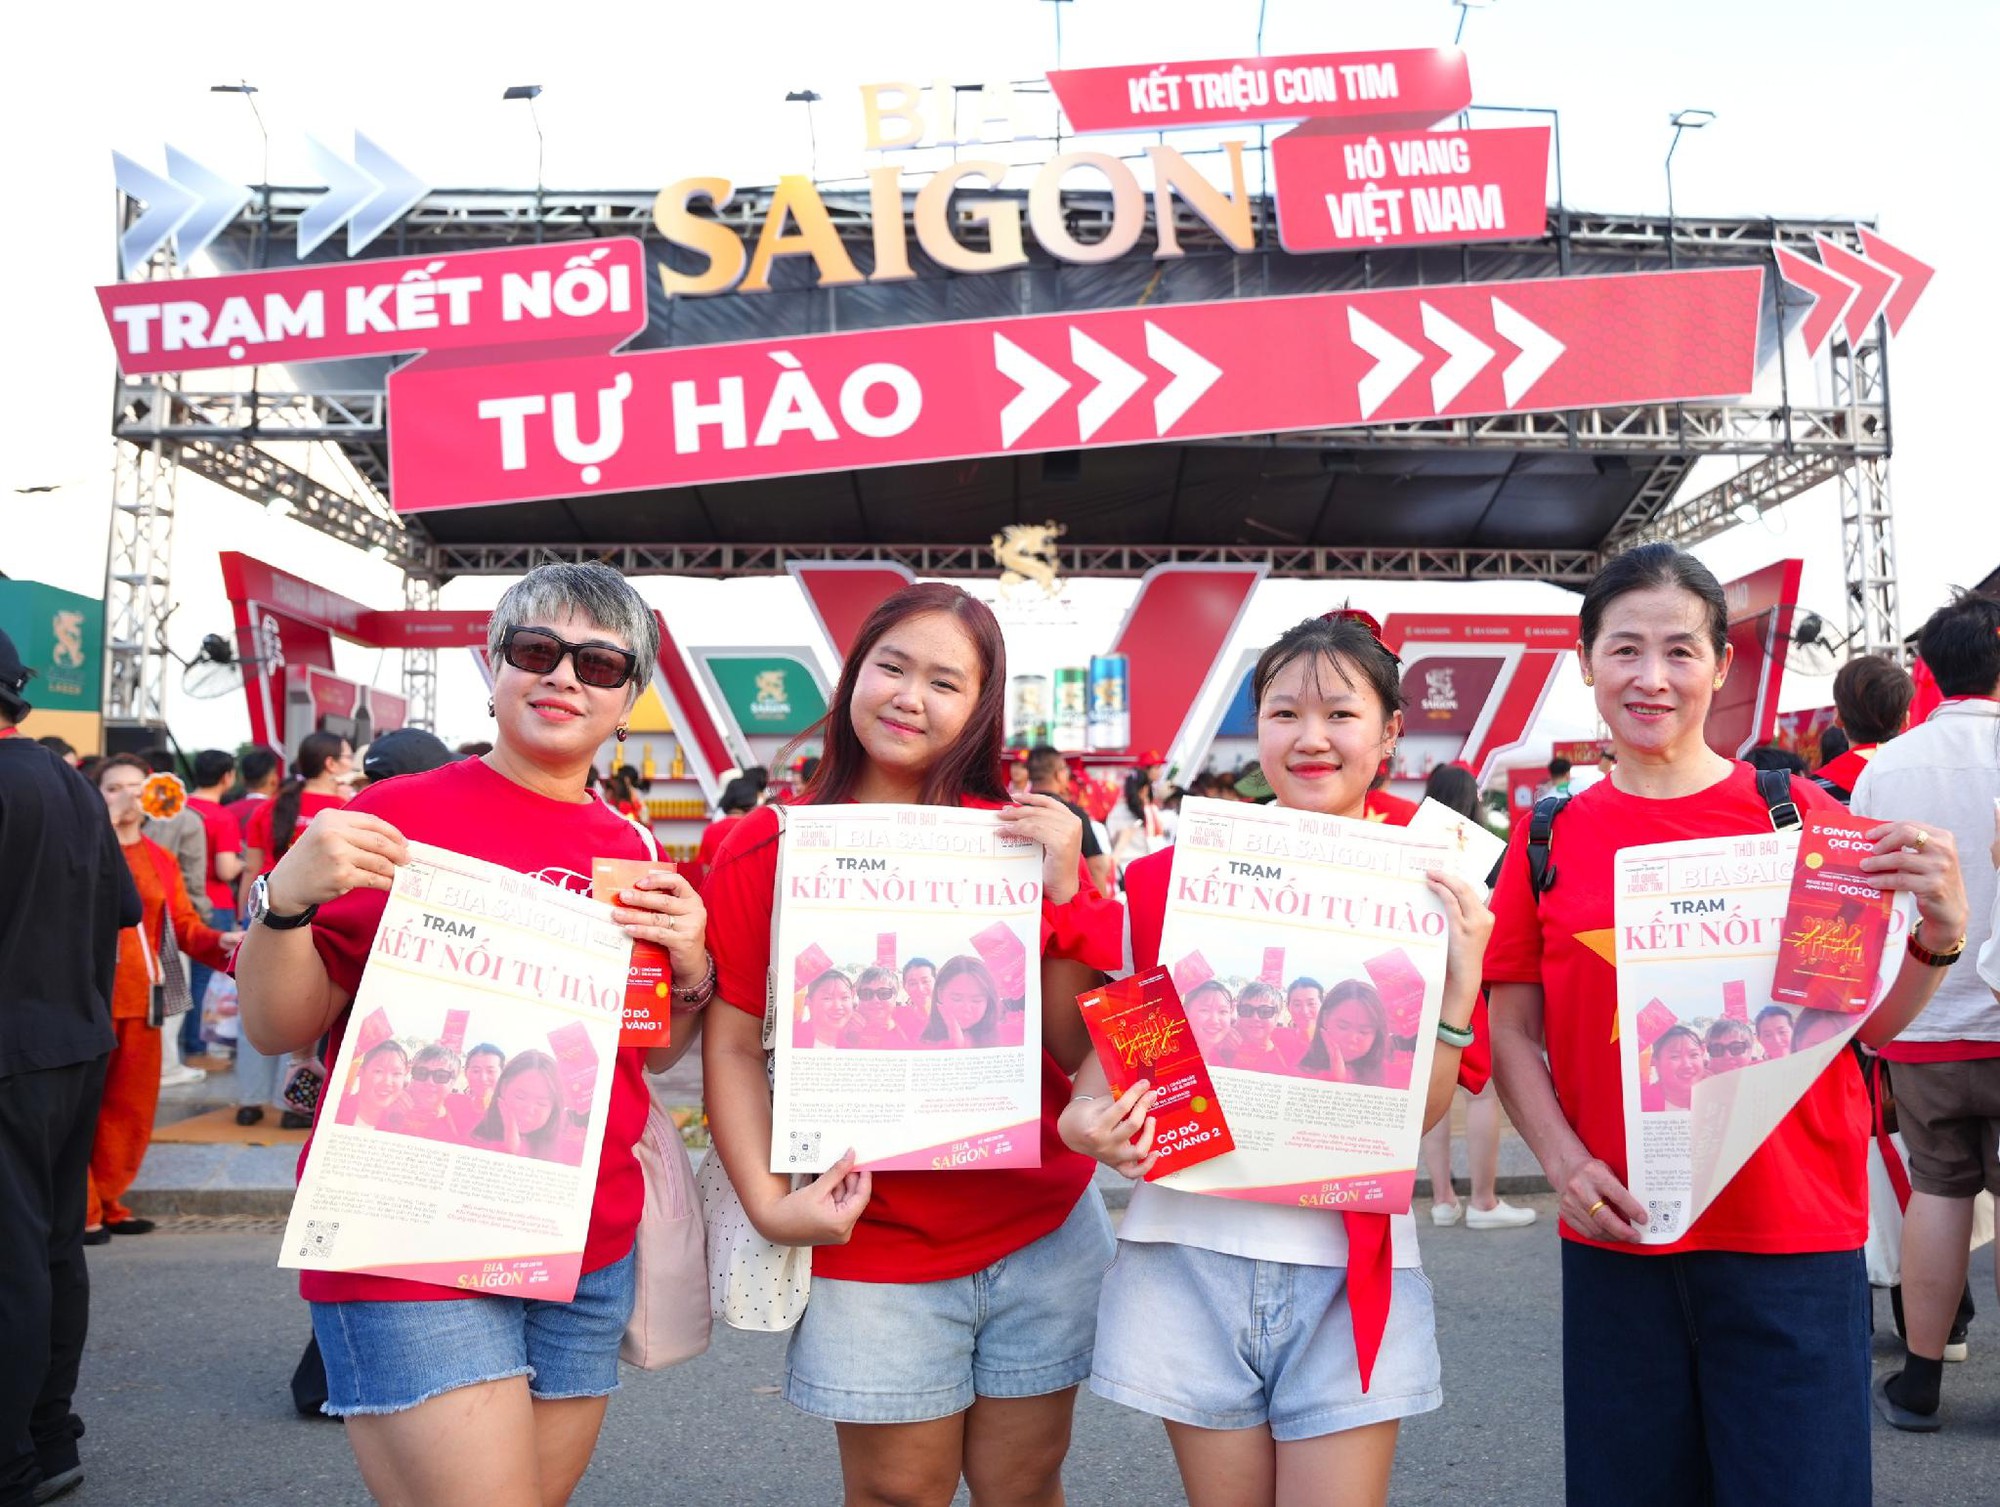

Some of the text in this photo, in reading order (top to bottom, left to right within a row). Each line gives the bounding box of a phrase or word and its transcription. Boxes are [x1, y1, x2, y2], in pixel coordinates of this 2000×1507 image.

[1129, 61, 1398, 115] KẾT TRIỆU CON TIM
[860, 78, 1039, 151] BIA
[1344, 136, 1470, 180] HÔ VANG
[653, 141, 1256, 299] SAIGON
[1326, 183, 1505, 243] VIỆT NAM
[114, 248, 631, 360] TRẠM KẾT NỐI
[478, 350, 922, 486] TỰ HÀO
[846, 830, 891, 848] BIA
[1812, 825, 1821, 834] 2
[1246, 834, 1290, 857] BIA
[836, 857, 886, 873] TRẠM
[1228, 860, 1282, 881] TRẠM
[1681, 862, 1731, 888] BIA
[1734, 858, 1794, 886] SAIG
[791, 864, 1040, 909] KẾT NỐI TỰ HÀO
[1838, 884, 1881, 899] 20:00
[444, 886, 489, 914] BIA
[1178, 867, 1445, 936] KẾT NỐI TỰ HÀO
[1670, 898, 1725, 917] TRẠM
[422, 913, 476, 939] TRẠM
[1625, 910, 1689, 950] KẾT
[1701, 904, 1763, 947] NỐI
[377, 919, 620, 1013] KẾT NỐI TỰ HÀO
[621, 1008, 649, 1019] Ờ ĐỎ
[625, 1019, 662, 1031] VÀNG 1
[1157, 1121, 1200, 1144] CỜ ĐỎ
[1174, 1131, 1210, 1153] VÀNG
[1212, 1127, 1221, 1138] 2
[931, 1145, 990, 1170] SAIGON
[1298, 1190, 1360, 1207] SAIGON
[1321, 1182, 1341, 1193] BIA
[457, 1270, 525, 1291] SAIGON
[482, 1261, 504, 1275] BIA
